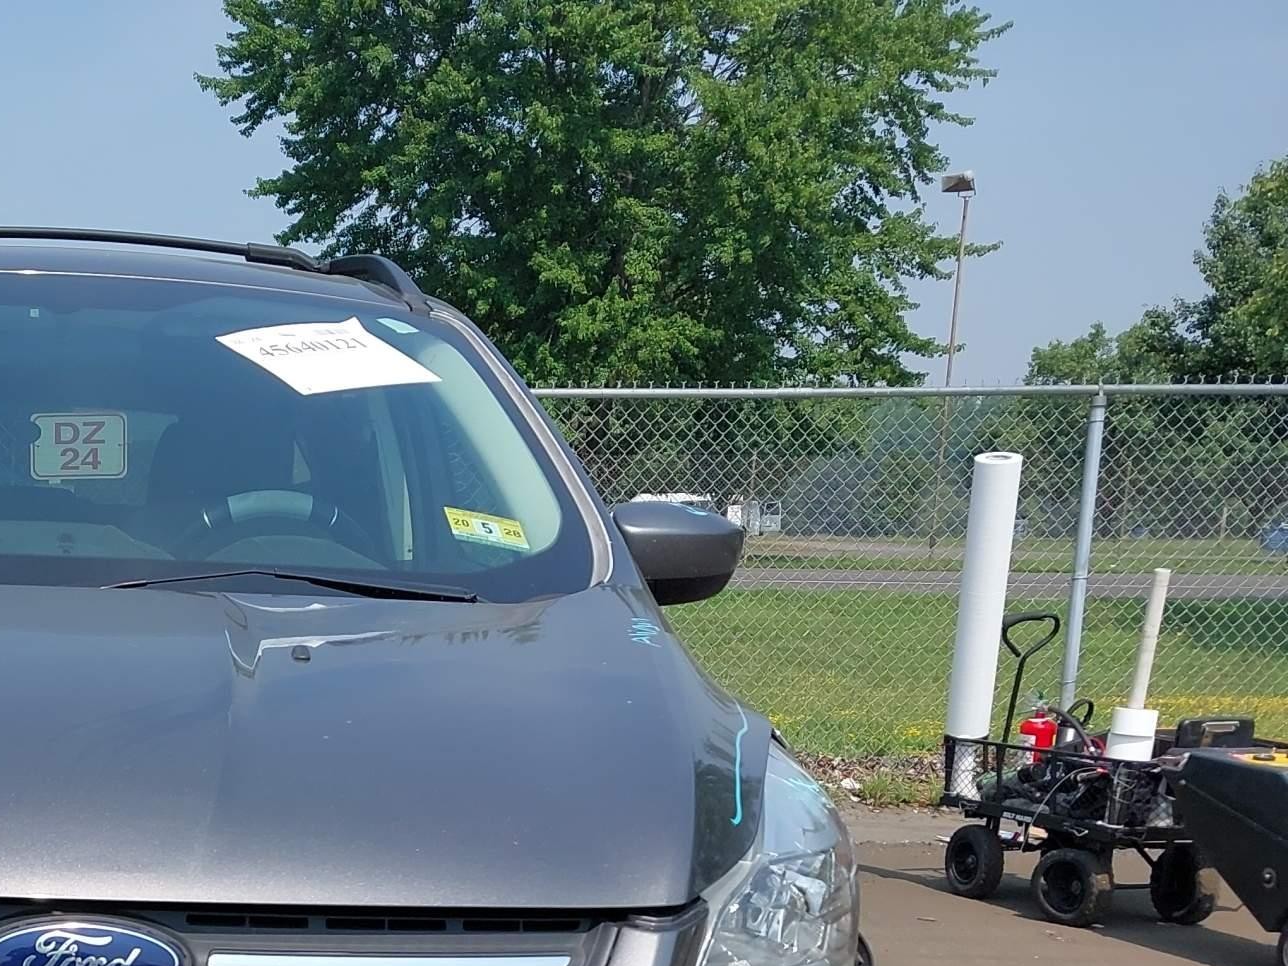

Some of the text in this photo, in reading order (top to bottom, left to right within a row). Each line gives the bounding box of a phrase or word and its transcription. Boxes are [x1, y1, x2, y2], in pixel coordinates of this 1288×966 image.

[54, 421, 106, 445] DZ
[60, 447, 102, 471] 24
[452, 517, 470, 528] 20
[480, 521, 494, 535] 5
